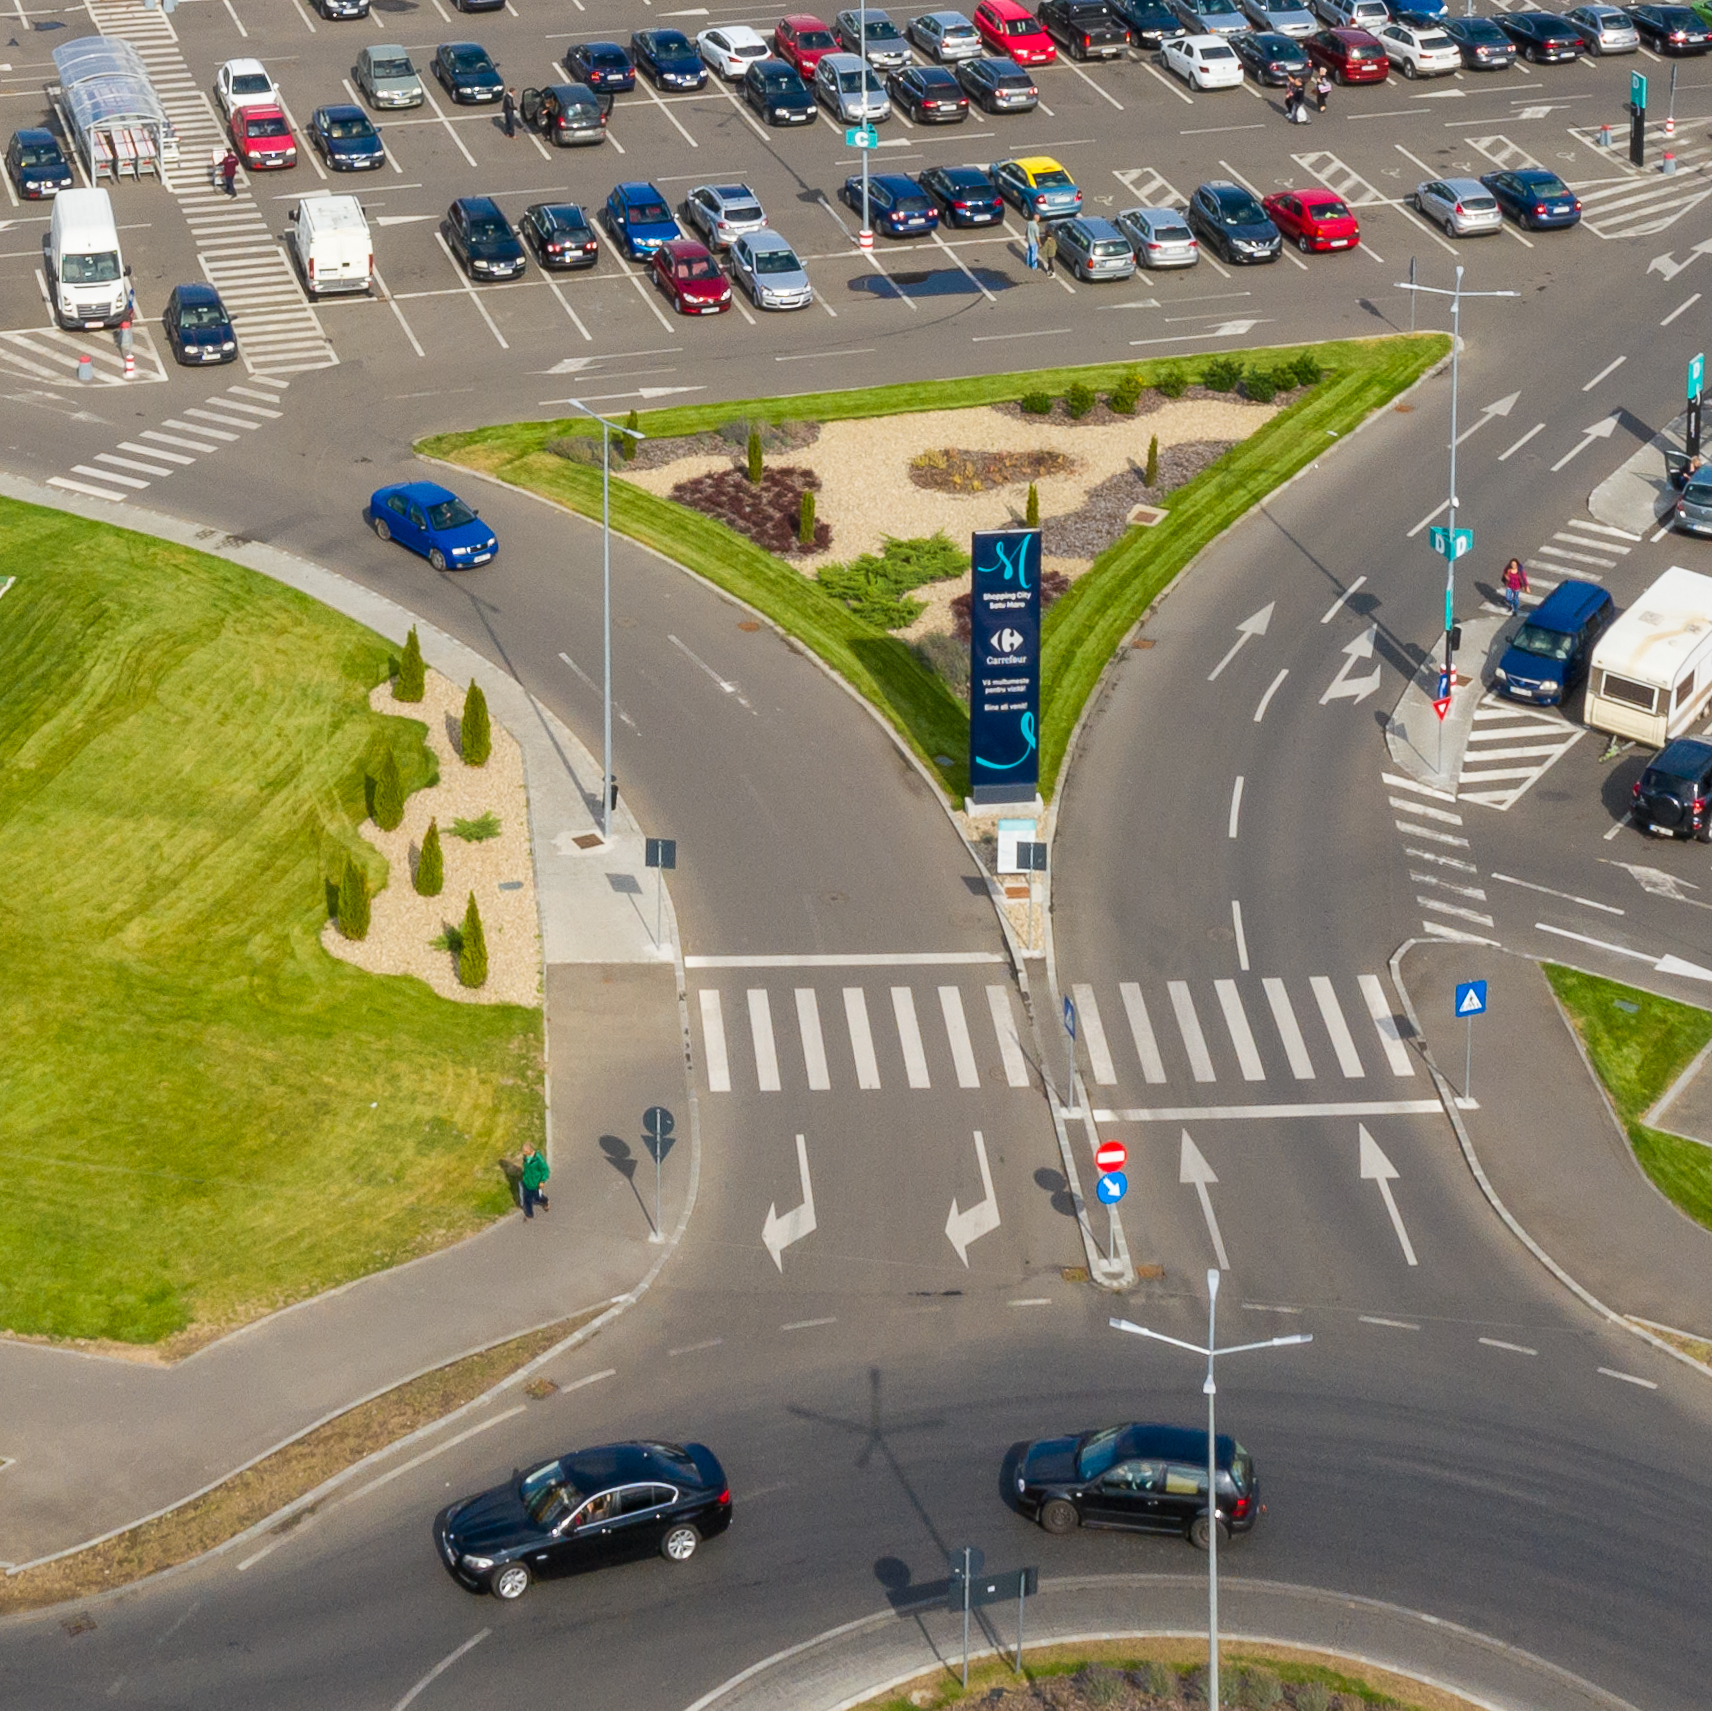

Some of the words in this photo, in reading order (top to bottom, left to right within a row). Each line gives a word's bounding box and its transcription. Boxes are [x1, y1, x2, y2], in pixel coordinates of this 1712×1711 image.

[854, 131, 869, 147] C
[1435, 532, 1446, 554] D
[1455, 535, 1467, 558] D
[986, 654, 1027, 665] Carrefour
